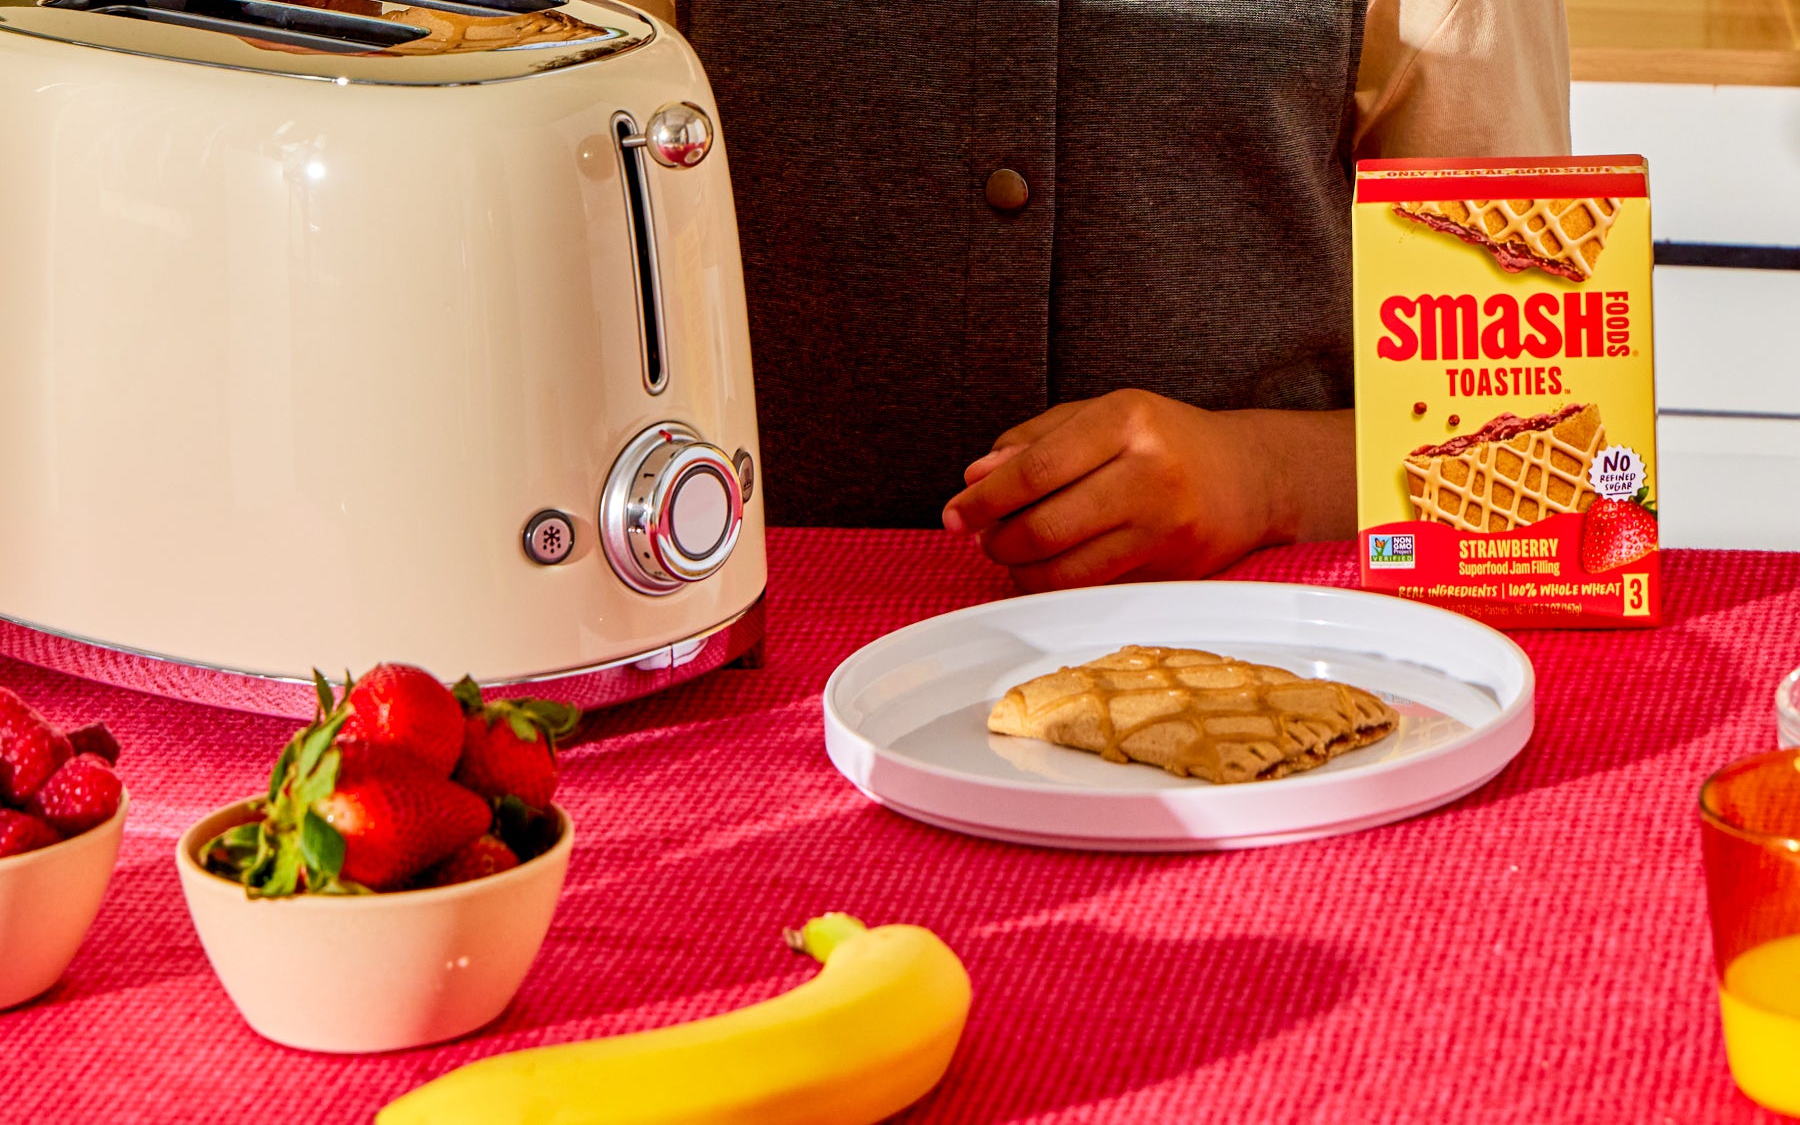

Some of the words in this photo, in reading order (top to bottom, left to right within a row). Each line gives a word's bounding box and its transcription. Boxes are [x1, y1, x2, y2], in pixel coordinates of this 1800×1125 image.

[1605, 291, 1630, 357] FOODS
[1446, 366, 1562, 397] TOASTIES
[1604, 451, 1630, 473] NO
[1600, 472, 1636, 483] REFINED
[1605, 482, 1632, 492] SUGAR
[1459, 538, 1559, 559] STRAWBERRY
[1459, 561, 1508, 577] Superfood
[1509, 561, 1530, 575] Jam
[1531, 560, 1560, 577] Filling
[1398, 586, 1424, 598] REAL
[1428, 584, 1498, 598] INGREDIENTS
[1509, 583, 1537, 597] 100%
[1540, 583, 1579, 597] WHOLE
[1581, 582, 1622, 597] WHEAT
[1630, 578, 1643, 610] 3
[1550, 602, 1561, 614] OZ
